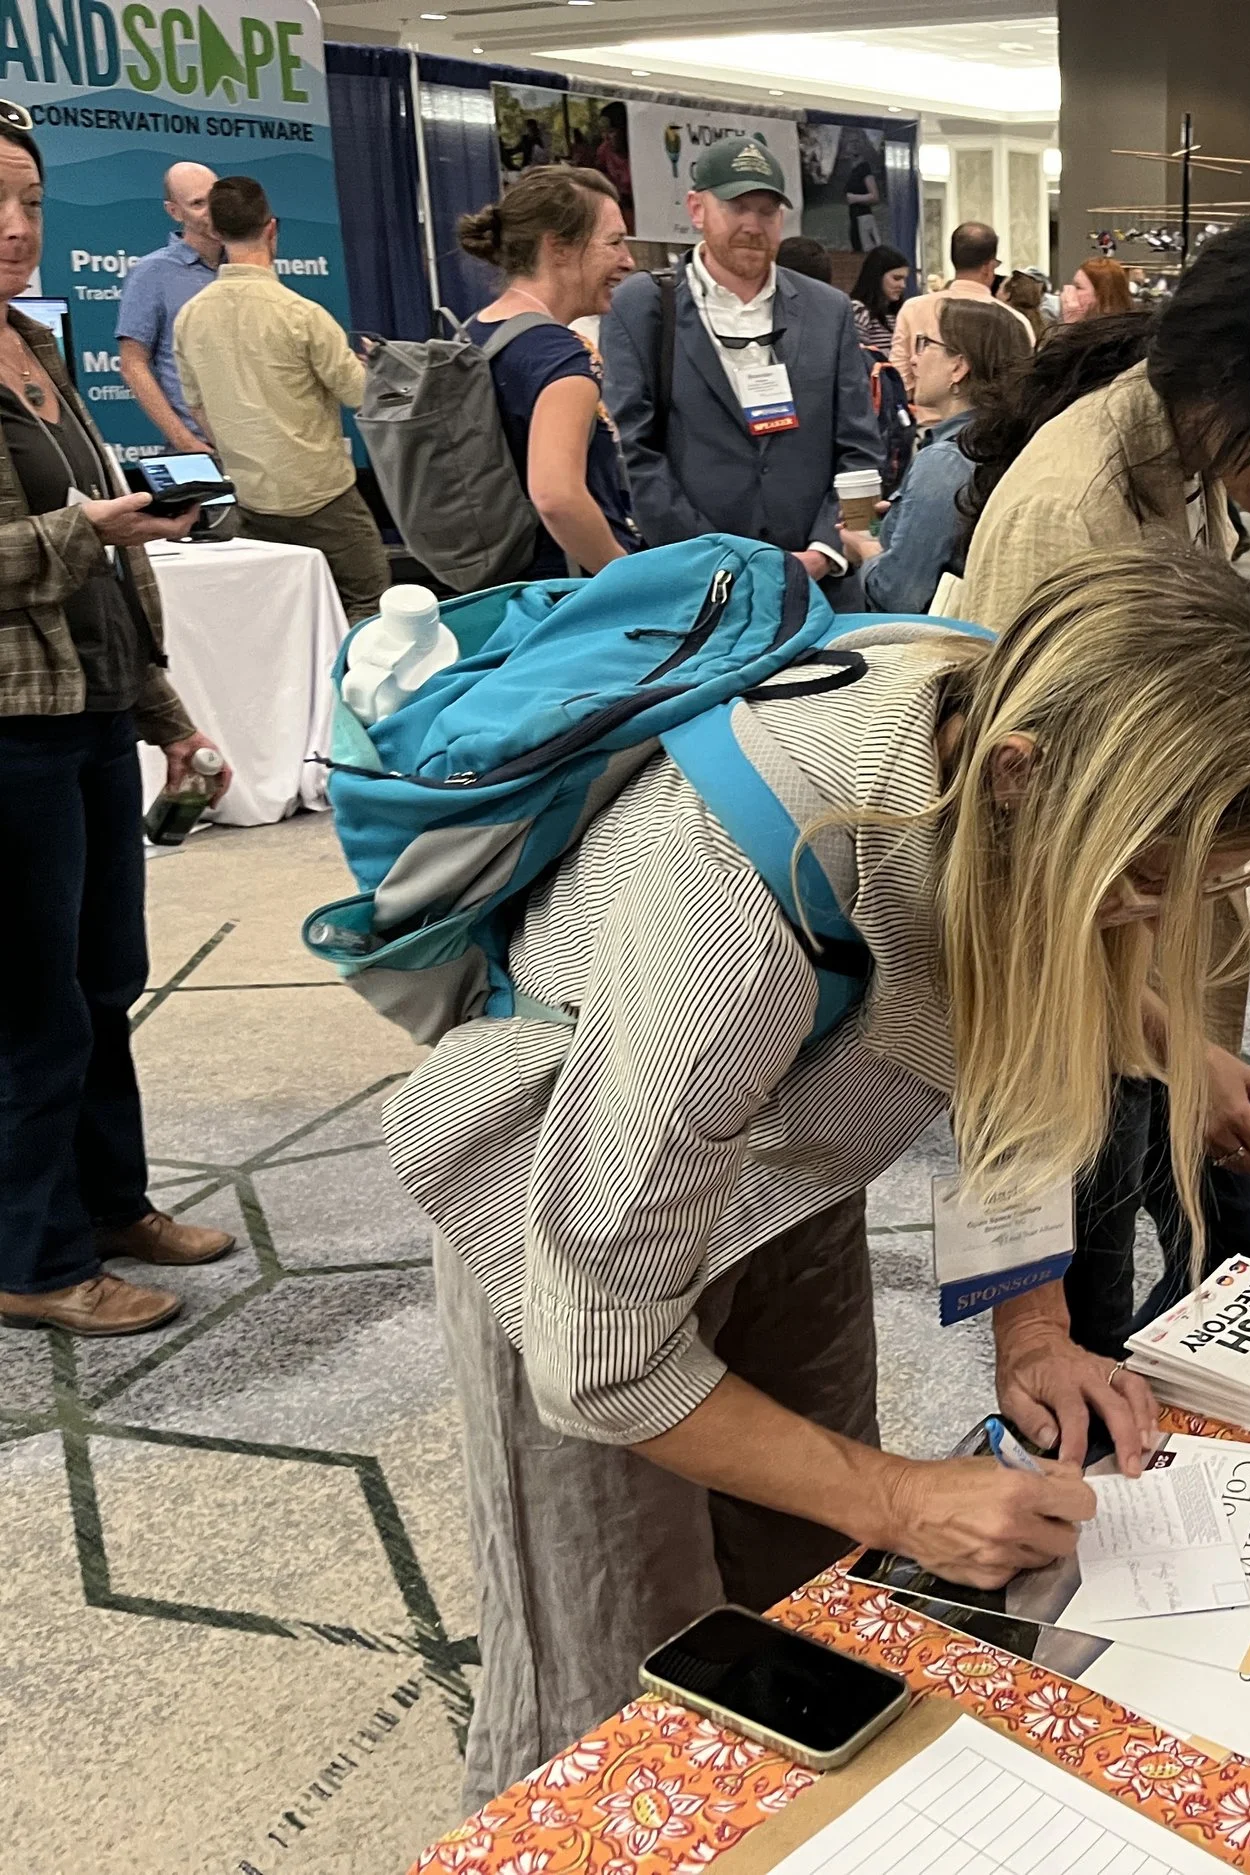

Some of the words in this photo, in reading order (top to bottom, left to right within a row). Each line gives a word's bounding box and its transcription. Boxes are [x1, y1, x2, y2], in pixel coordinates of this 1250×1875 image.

[32, 105, 199, 134] CONSERVATION
[206, 120, 314, 142] SOFTWARE
[71, 250, 140, 278] Proje
[273, 256, 329, 276] ment
[957, 1270, 1054, 1311] SPONSOR
